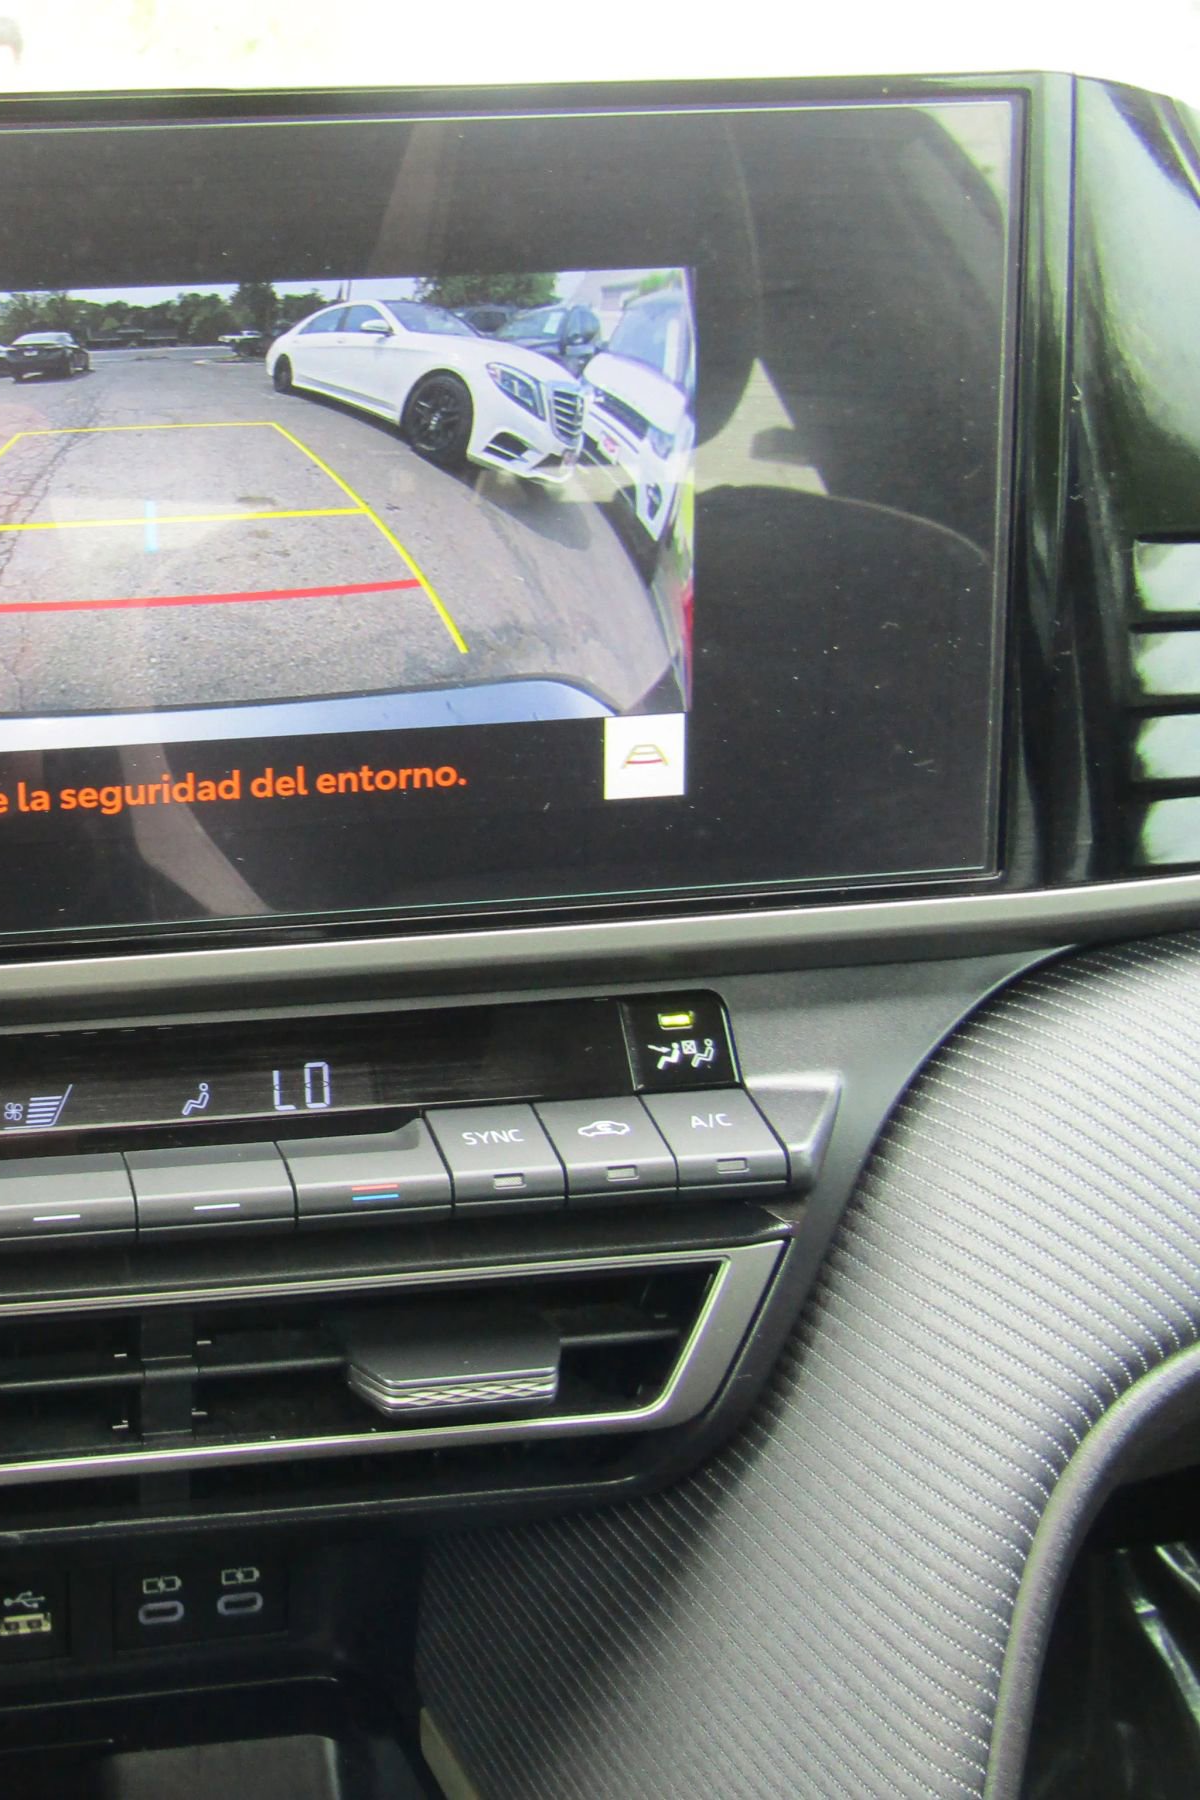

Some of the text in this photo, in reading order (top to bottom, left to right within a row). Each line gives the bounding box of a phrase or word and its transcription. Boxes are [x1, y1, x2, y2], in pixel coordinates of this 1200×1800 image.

[16, 781, 51, 812] la
[59, 769, 241, 815] seguridad
[249, 765, 309, 798] del
[316, 764, 468, 793] entorno.
[690, 1112, 733, 1129] A/C
[462, 1128, 525, 1146] SYNC
